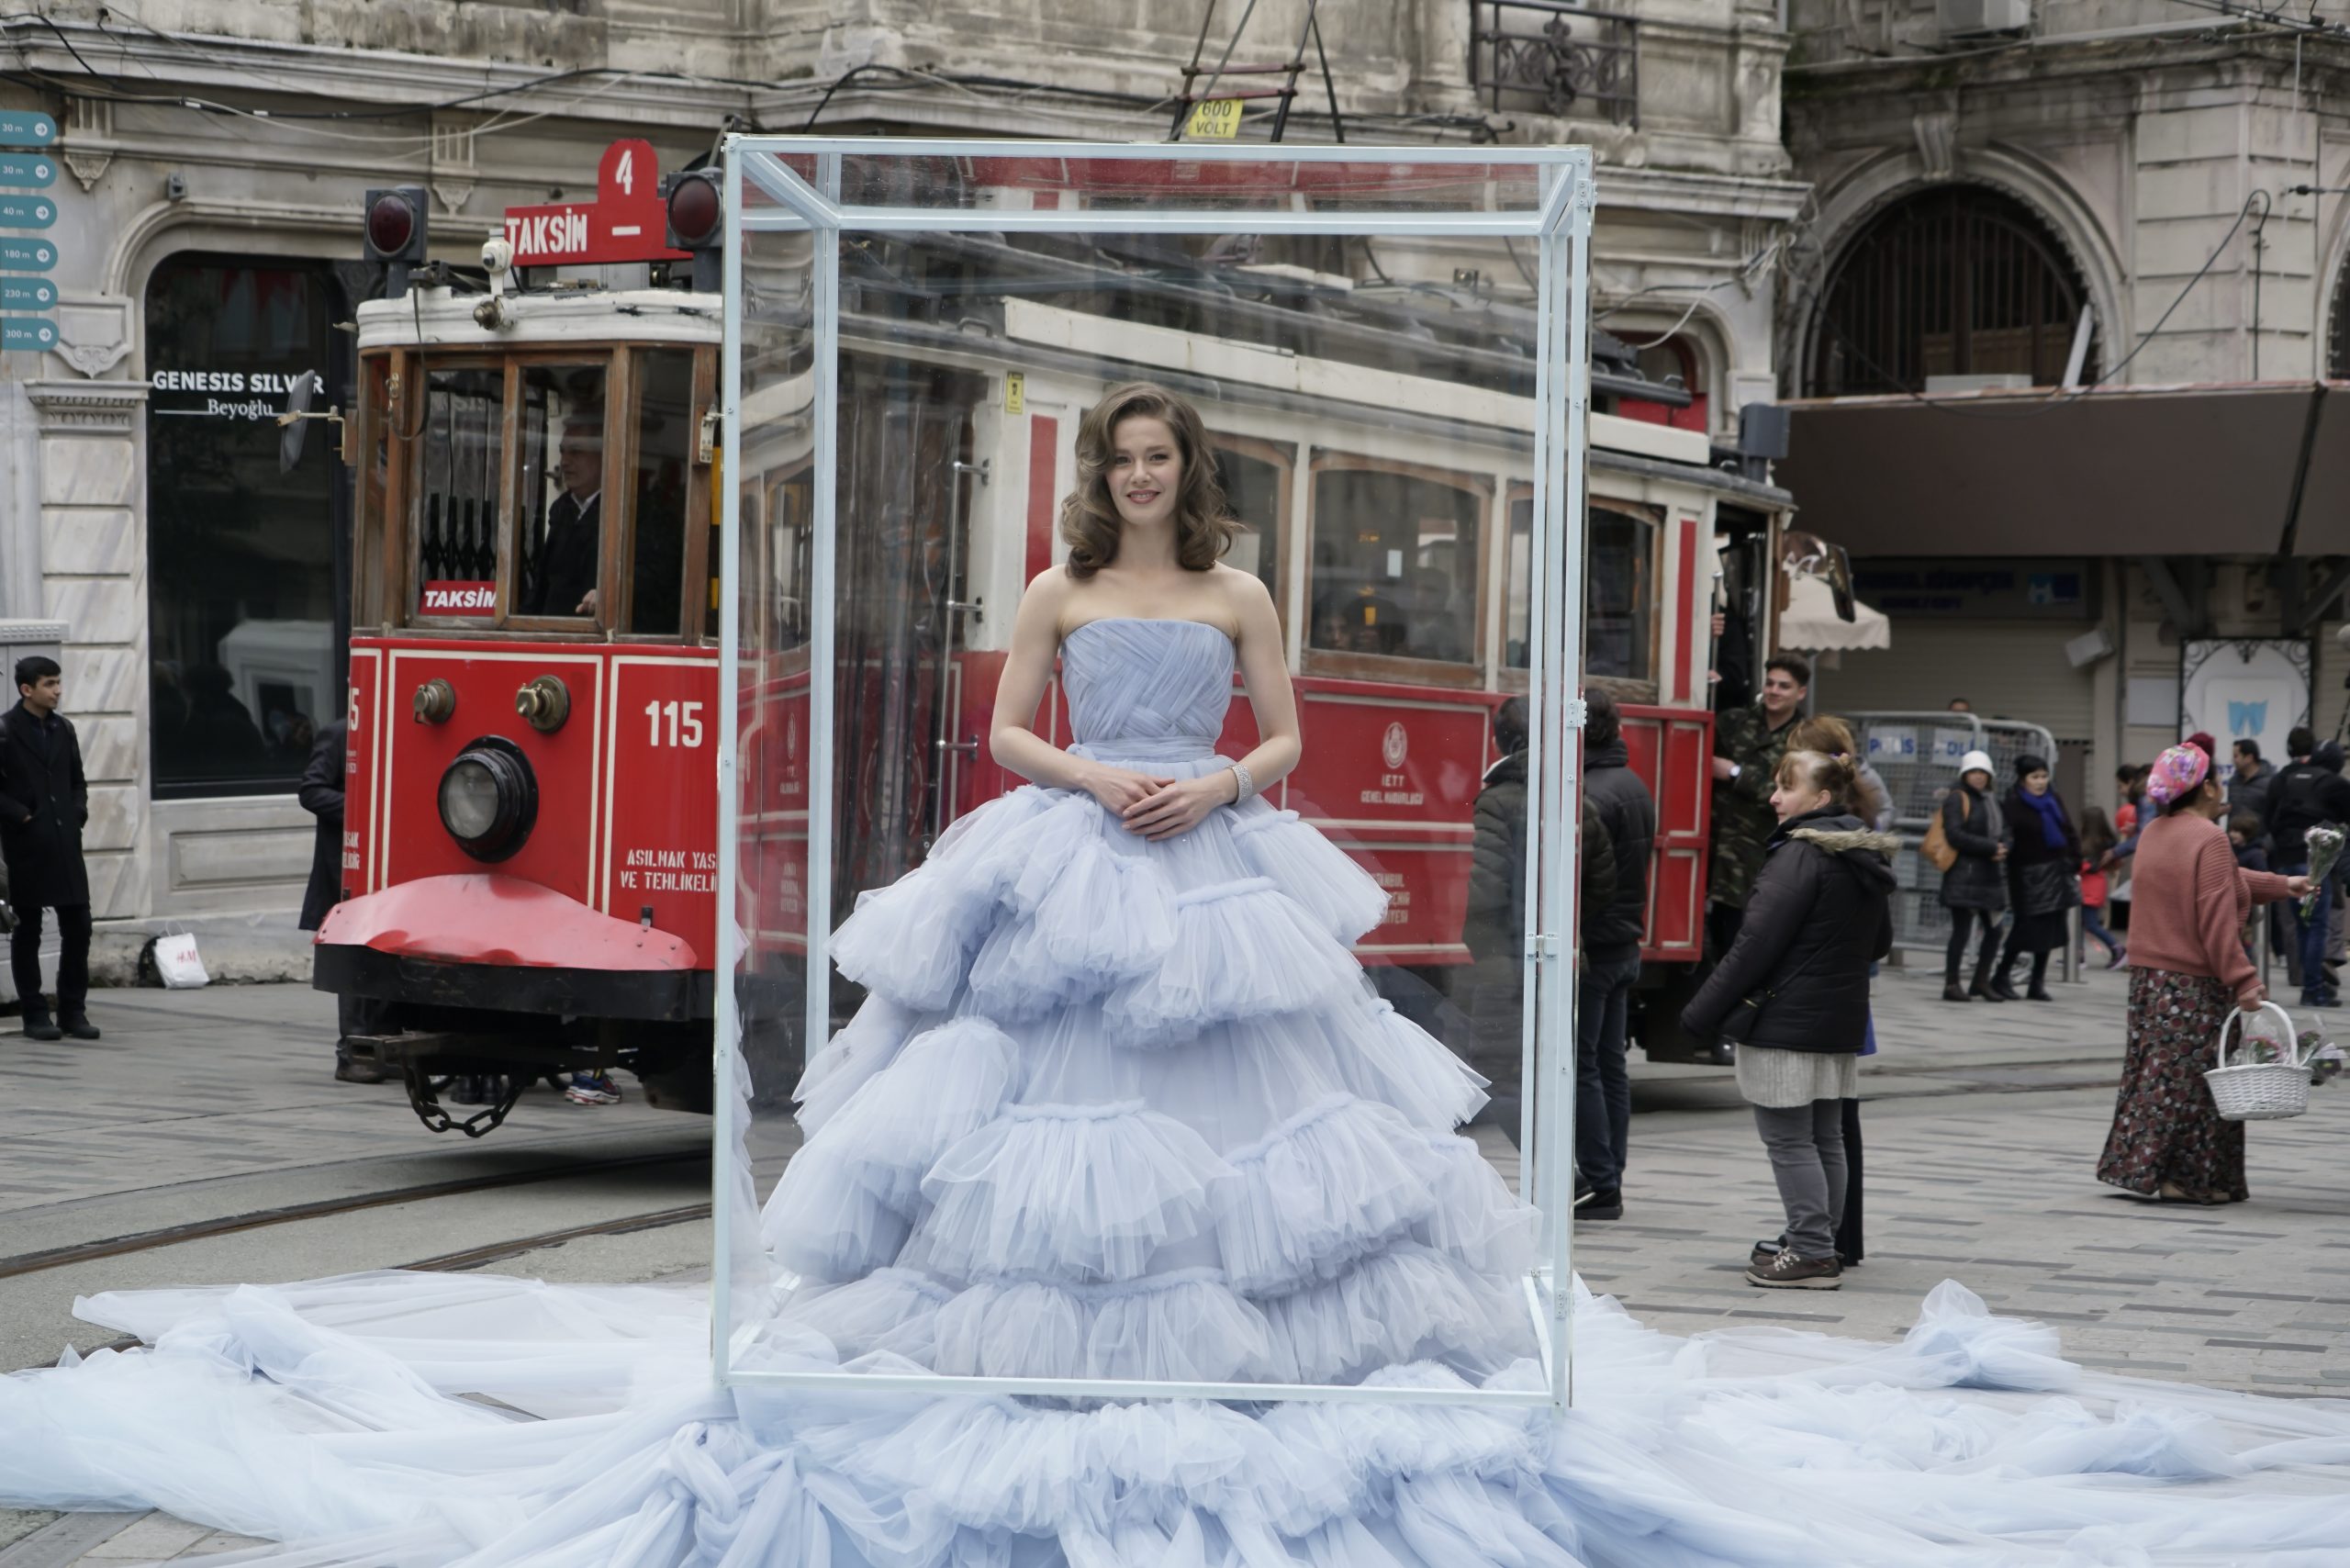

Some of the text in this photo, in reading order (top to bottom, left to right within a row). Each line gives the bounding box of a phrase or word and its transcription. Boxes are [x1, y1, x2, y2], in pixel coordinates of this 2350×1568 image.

[1203, 101, 1232, 117] 600
[2, 123, 13, 132] 30
[1196, 121, 1230, 135] VOLT
[3, 166, 15, 174] 30
[615, 150, 632, 196] 4
[3, 207, 15, 216] 40
[506, 207, 588, 256] TAKSİM
[5, 250, 20, 259] 180
[5, 290, 21, 298] 230
[6, 330, 22, 339] 300
[152, 371, 325, 394] GENESIS SILVR
[207, 398, 274, 420] Beyoğlu
[645, 700, 703, 747] 115
[627, 849, 716, 869] ASILMAK YAS
[621, 870, 716, 892] VE TEHLİKELİ
